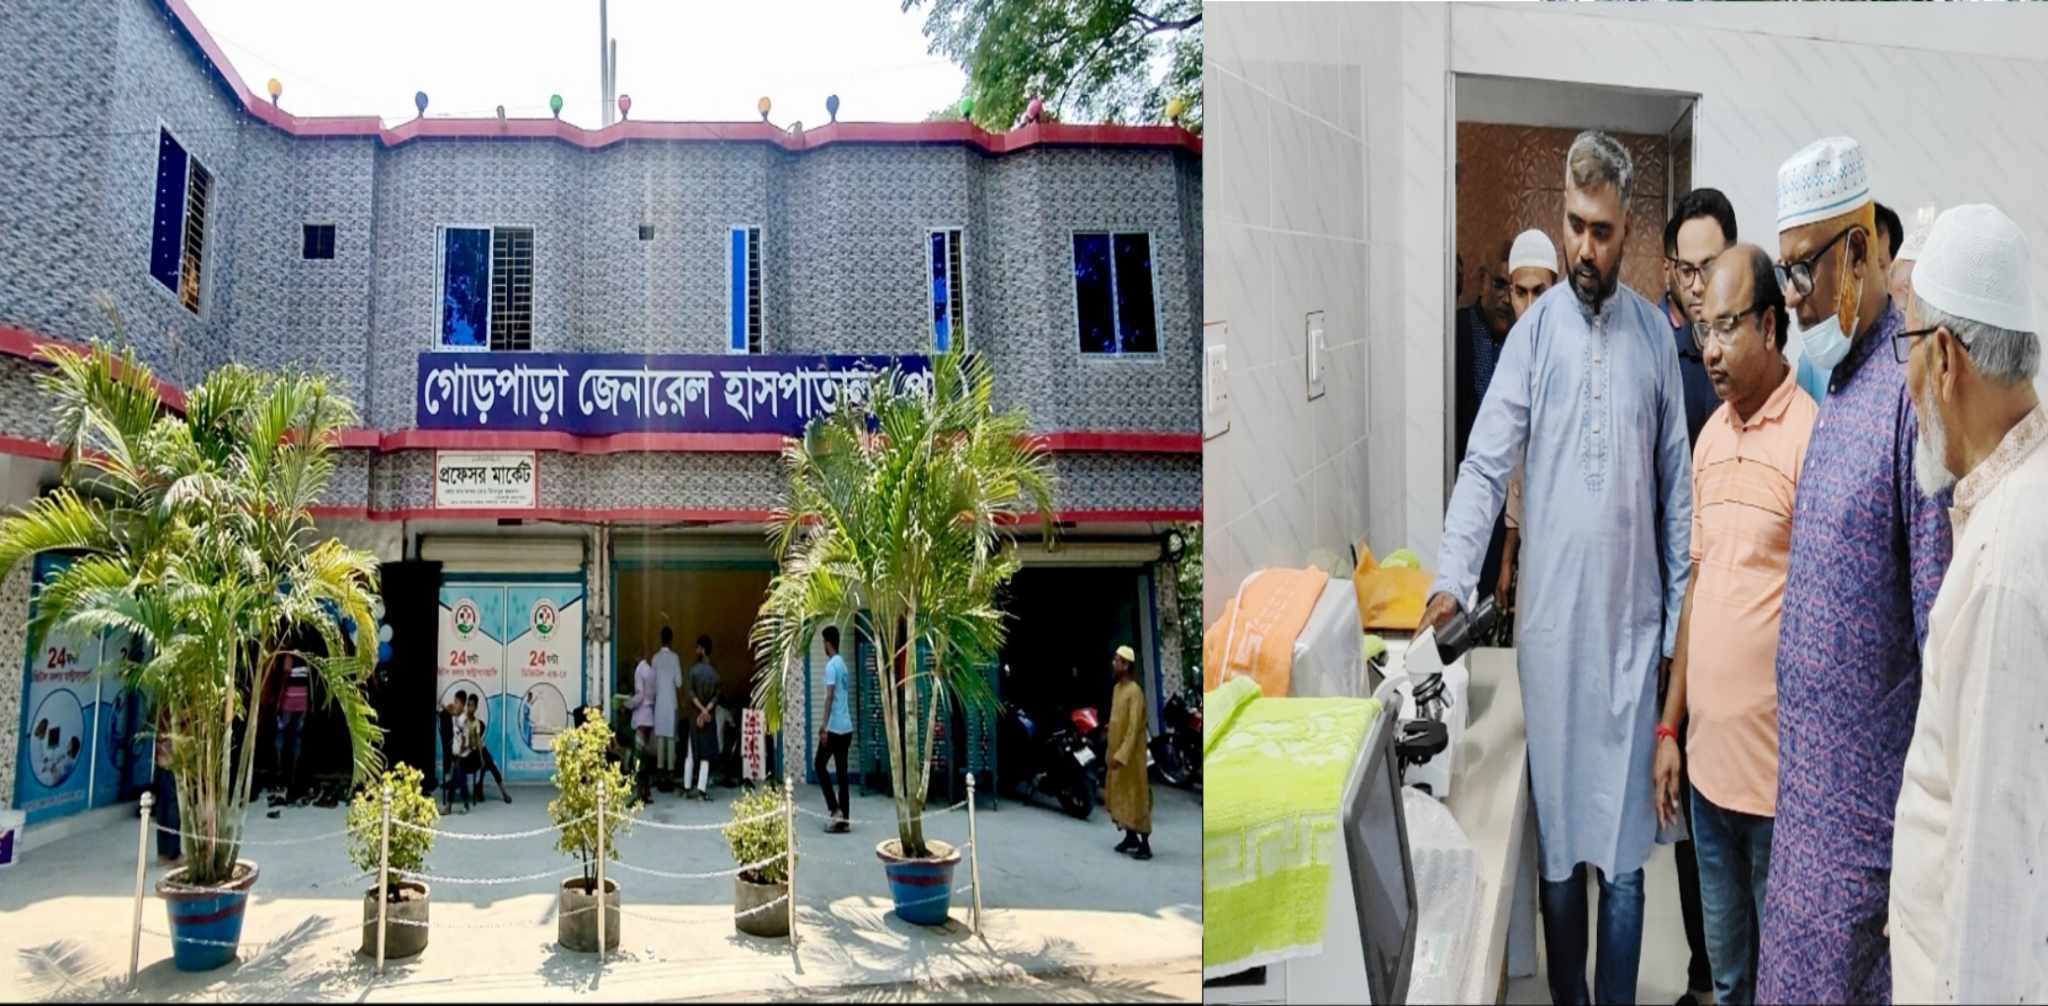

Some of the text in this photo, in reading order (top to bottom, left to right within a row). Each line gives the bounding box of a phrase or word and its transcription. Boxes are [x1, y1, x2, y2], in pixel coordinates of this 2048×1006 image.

[425, 362, 569, 424] গোড়পাড়া
[578, 364, 713, 419] জেনারেল
[440, 460, 531, 485] প্রফেসর মার্কেট
[47, 647, 66, 669] 24
